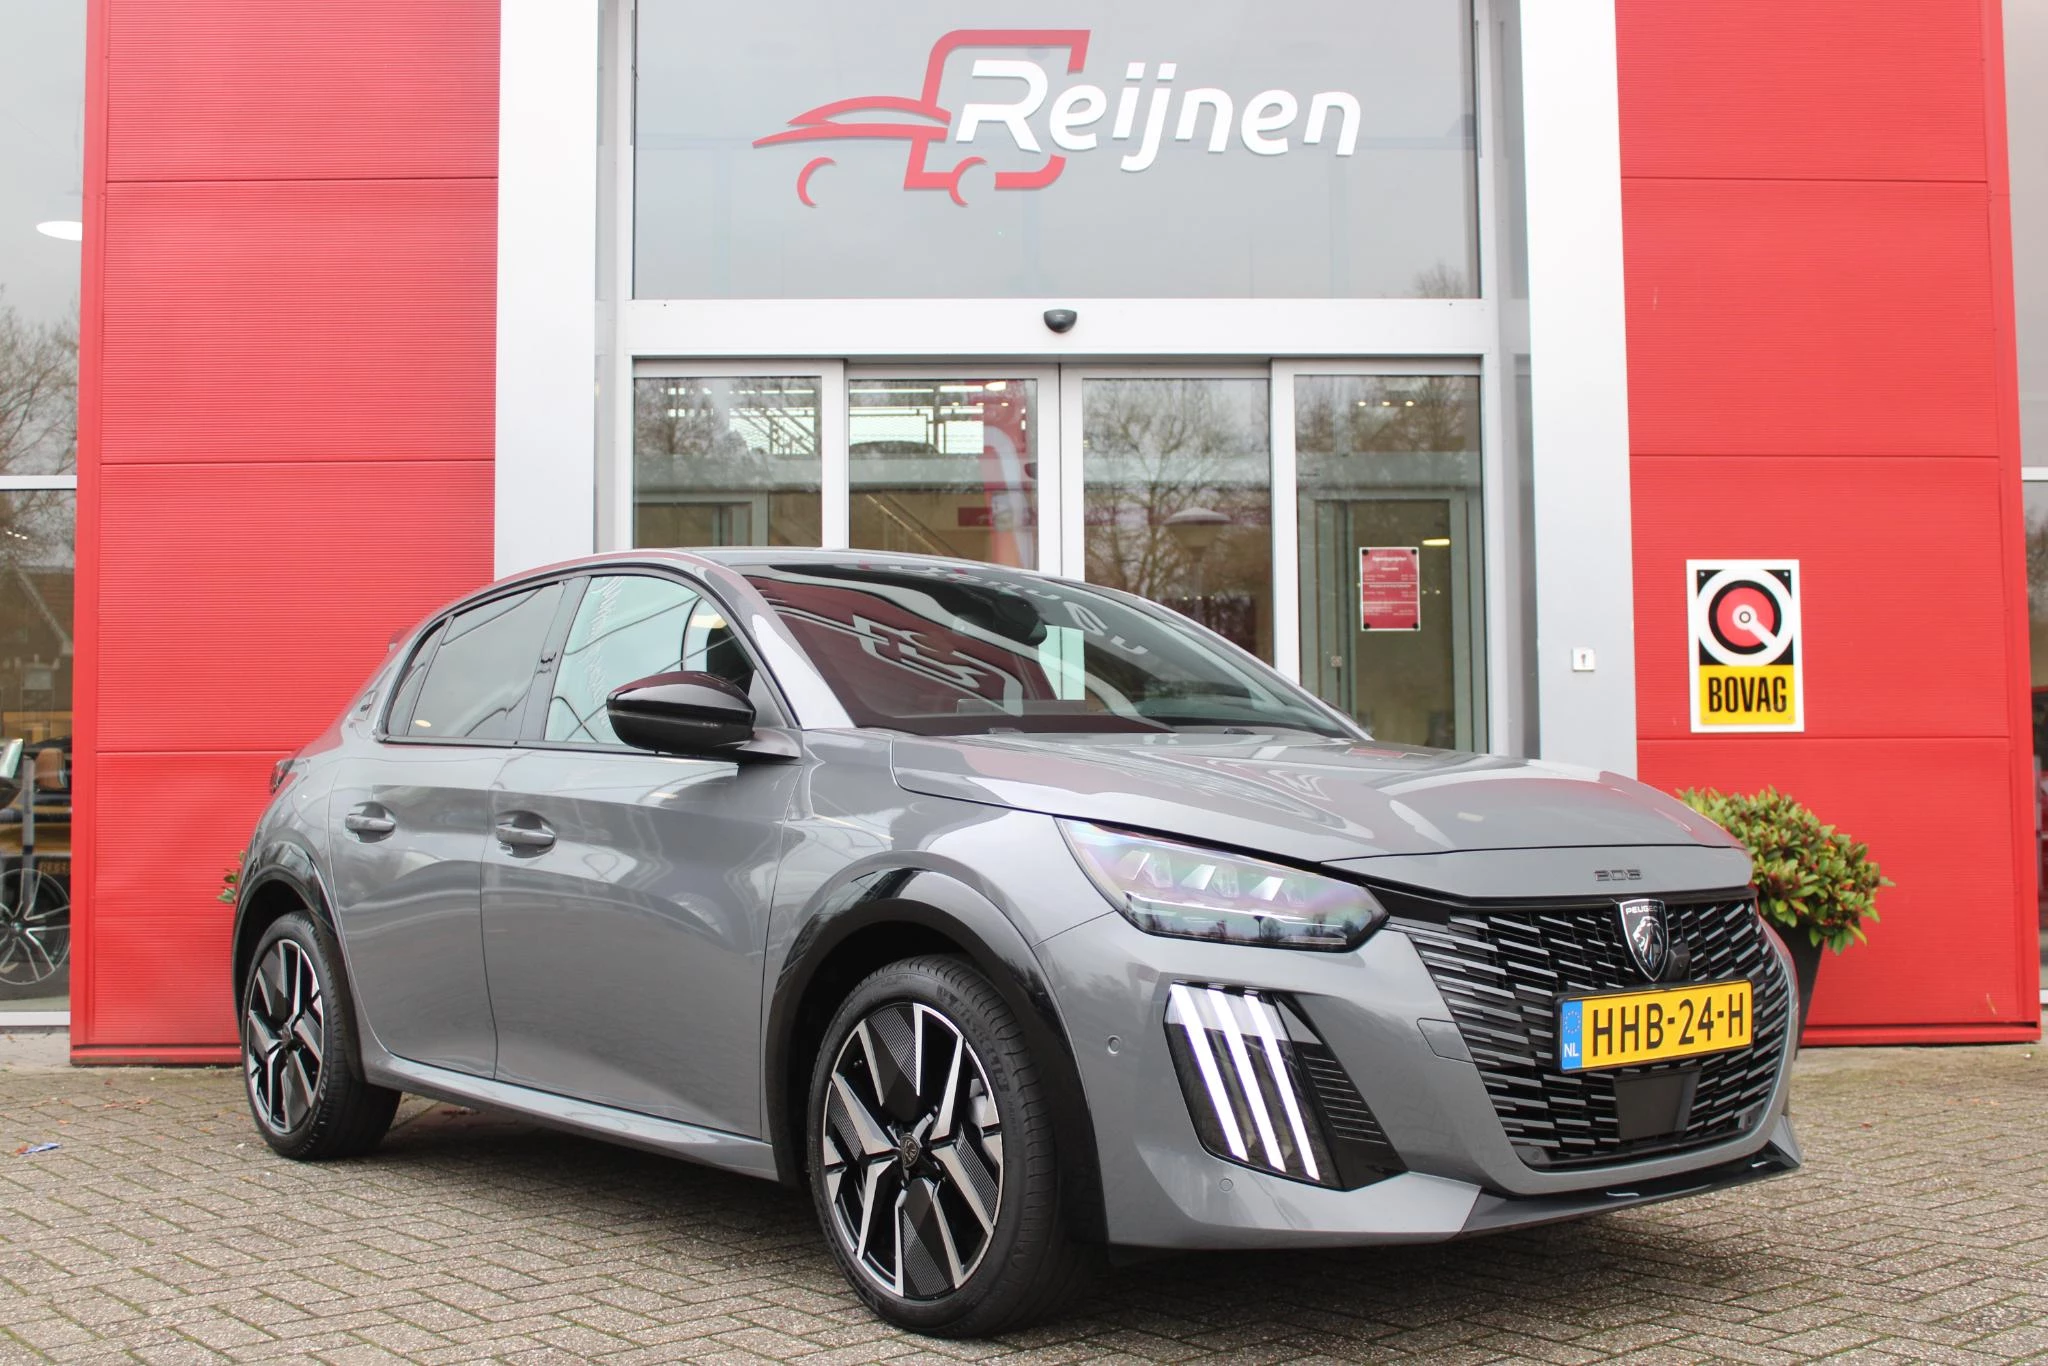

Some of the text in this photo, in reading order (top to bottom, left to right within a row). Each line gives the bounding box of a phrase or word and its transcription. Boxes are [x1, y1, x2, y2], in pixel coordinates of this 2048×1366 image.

[955, 59, 1361, 173] Reijnen
[1708, 676, 1787, 713] BOVAG
[1592, 992, 1744, 1057] HHB-24-H
[1564, 1044, 1579, 1058] NL
